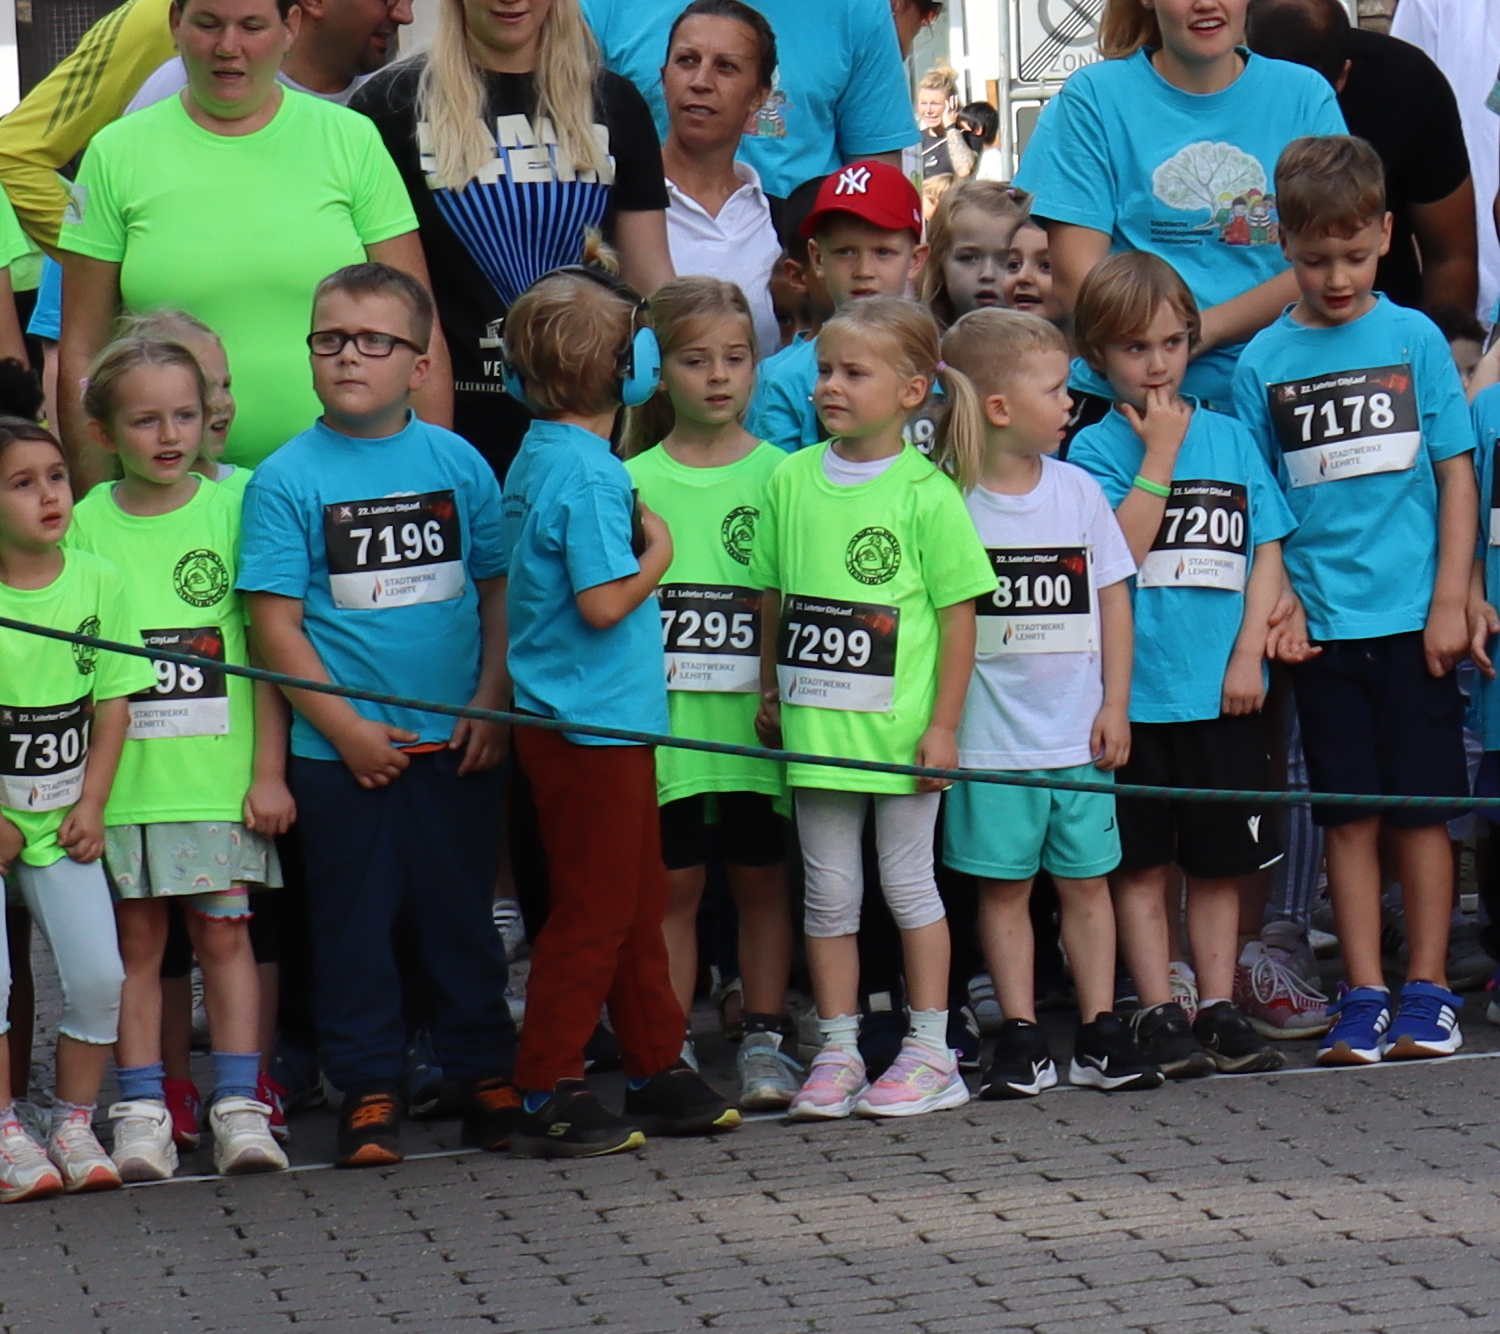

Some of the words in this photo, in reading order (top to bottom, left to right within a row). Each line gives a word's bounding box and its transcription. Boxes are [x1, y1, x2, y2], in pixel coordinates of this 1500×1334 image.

[455, 381, 507, 393] ELSENKIRCH
[1294, 392, 1395, 442] 7178
[1328, 444, 1382, 460] STADTWERKE
[1329, 457, 1360, 469] LEHRTE
[1165, 506, 1244, 547] 7200
[349, 520, 444, 565] 7196
[1188, 558, 1234, 568] STADTWERKE
[1188, 568, 1219, 577] LEHRTE
[384, 573, 437, 586] STADTWERKE
[385, 585, 417, 595] LEHRTE
[992, 574, 1071, 607] 8100
[660, 609, 754, 648] 7295
[1015, 622, 1065, 632] STADTWERKE
[1015, 632, 1045, 641] LEHRTE
[788, 623, 871, 667] 7299
[681, 662, 735, 671] STADTWERKE
[153, 659, 204, 694] 98
[680, 672, 712, 681] LEHRTE
[799, 677, 852, 690] STADTWERKE
[799, 687, 826, 697] LEHRTE
[133, 708, 188, 718] STADTWERKE
[133, 719, 166, 728] LEHRTE
[9, 719, 90, 769] 7301
